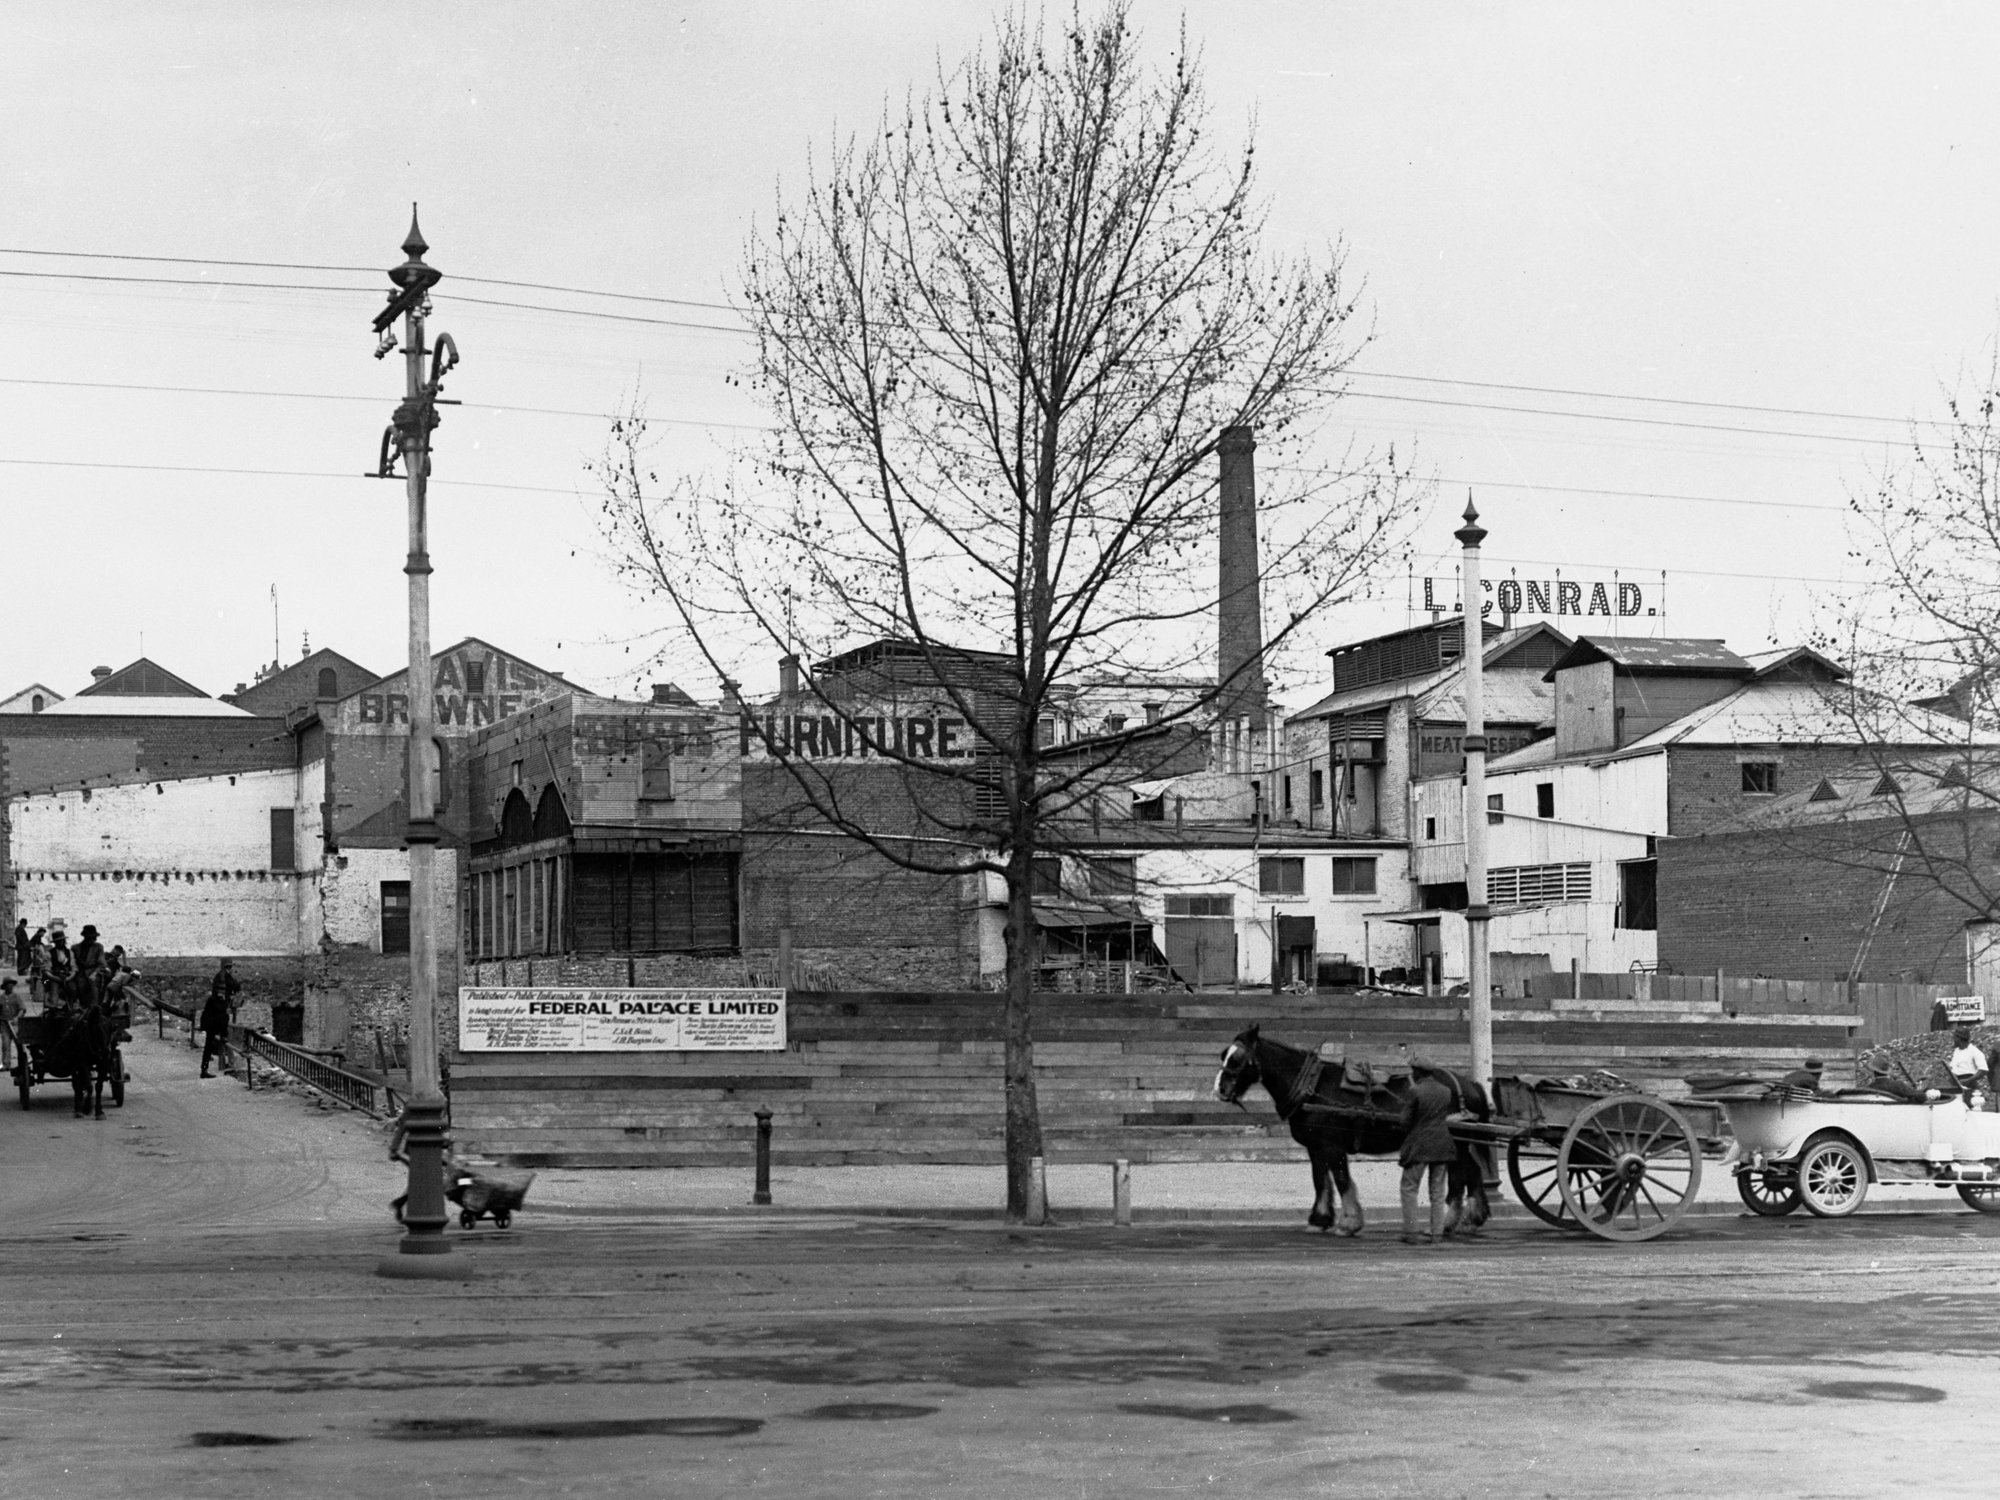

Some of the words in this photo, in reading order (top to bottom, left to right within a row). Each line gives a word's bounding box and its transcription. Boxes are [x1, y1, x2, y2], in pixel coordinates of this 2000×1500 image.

[1424, 577, 1463, 612] L.
[435, 651, 538, 690] AVIS
[360, 694, 522, 726] BRWNE
[1421, 736, 1462, 753] MEAT
[529, 1002, 612, 1014] FEDERAL
[619, 1002, 702, 1014] PALACE
[708, 1002, 779, 1015] LIMITED
[1946, 1003, 1981, 1011] ADMITTANCE
